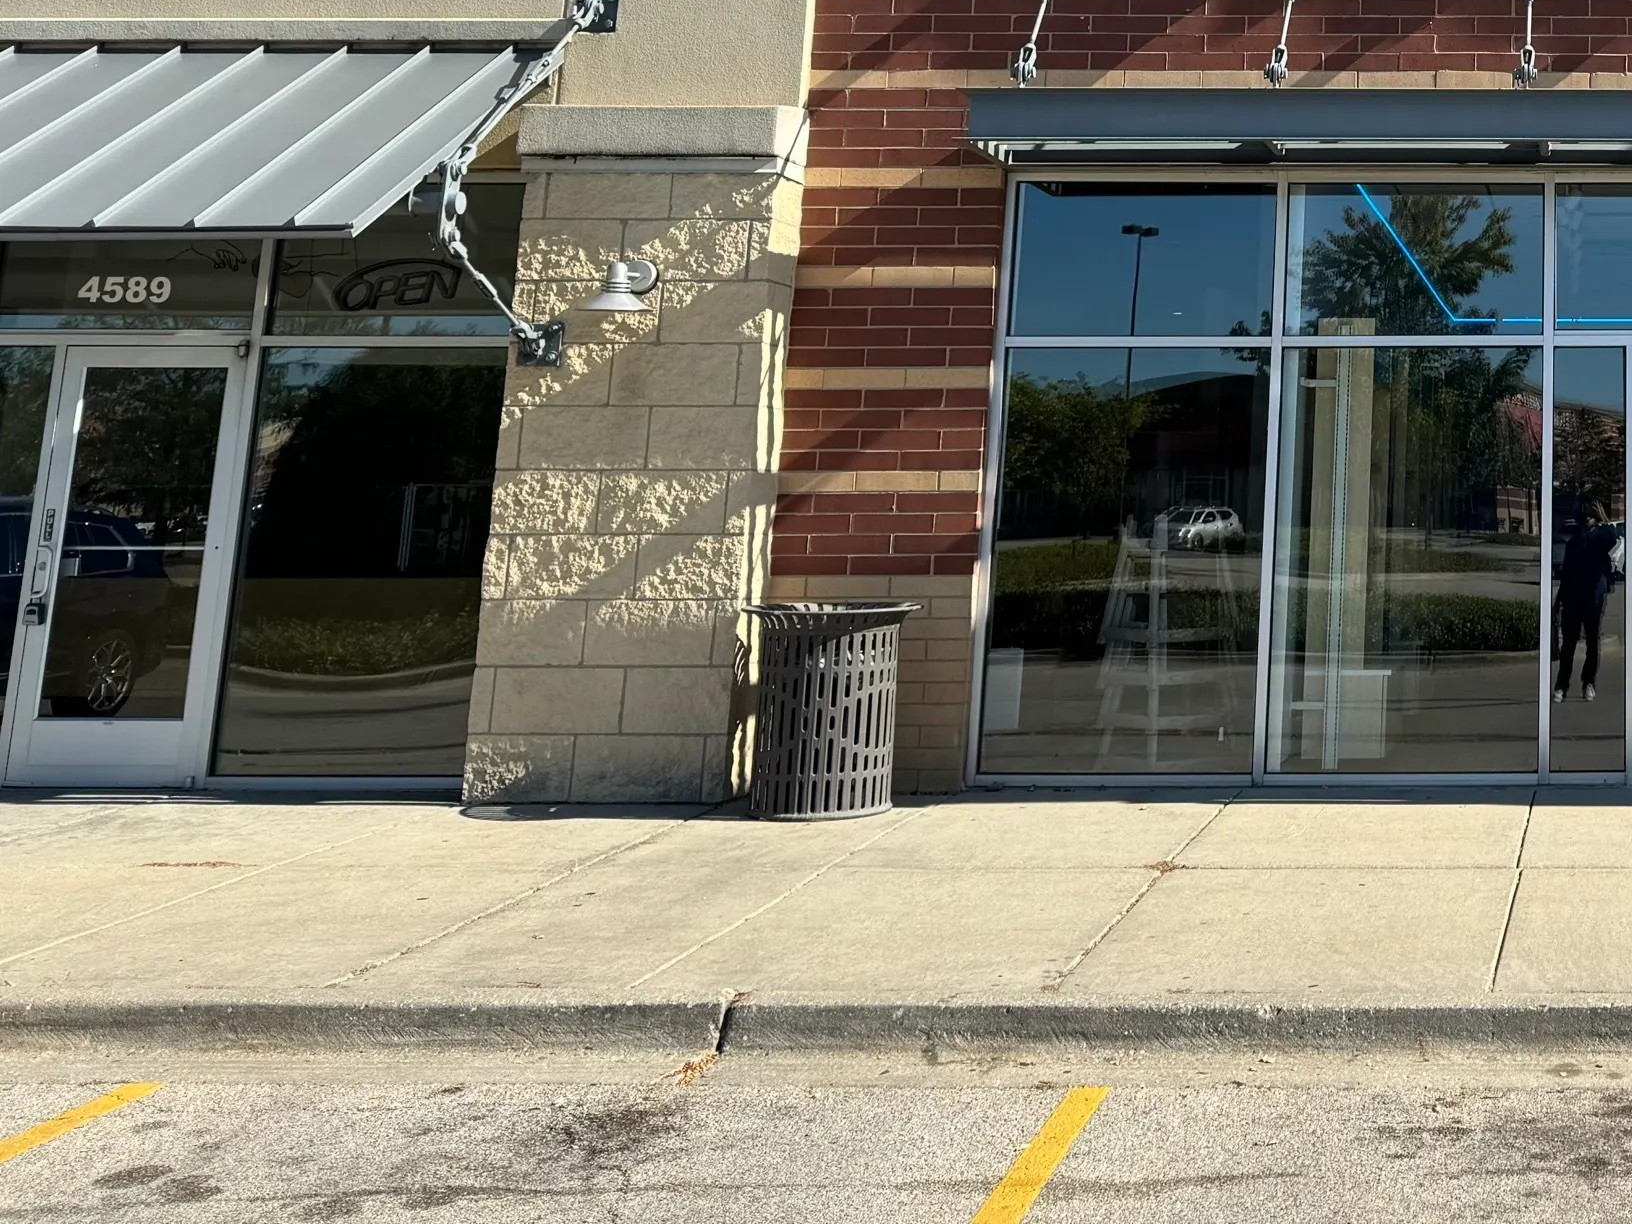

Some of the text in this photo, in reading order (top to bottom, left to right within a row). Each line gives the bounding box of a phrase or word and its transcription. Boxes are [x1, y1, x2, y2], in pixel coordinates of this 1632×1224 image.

[77, 276, 171, 303] 4589
[337, 268, 462, 311] OPEN
[45, 509, 55, 540] PULL
